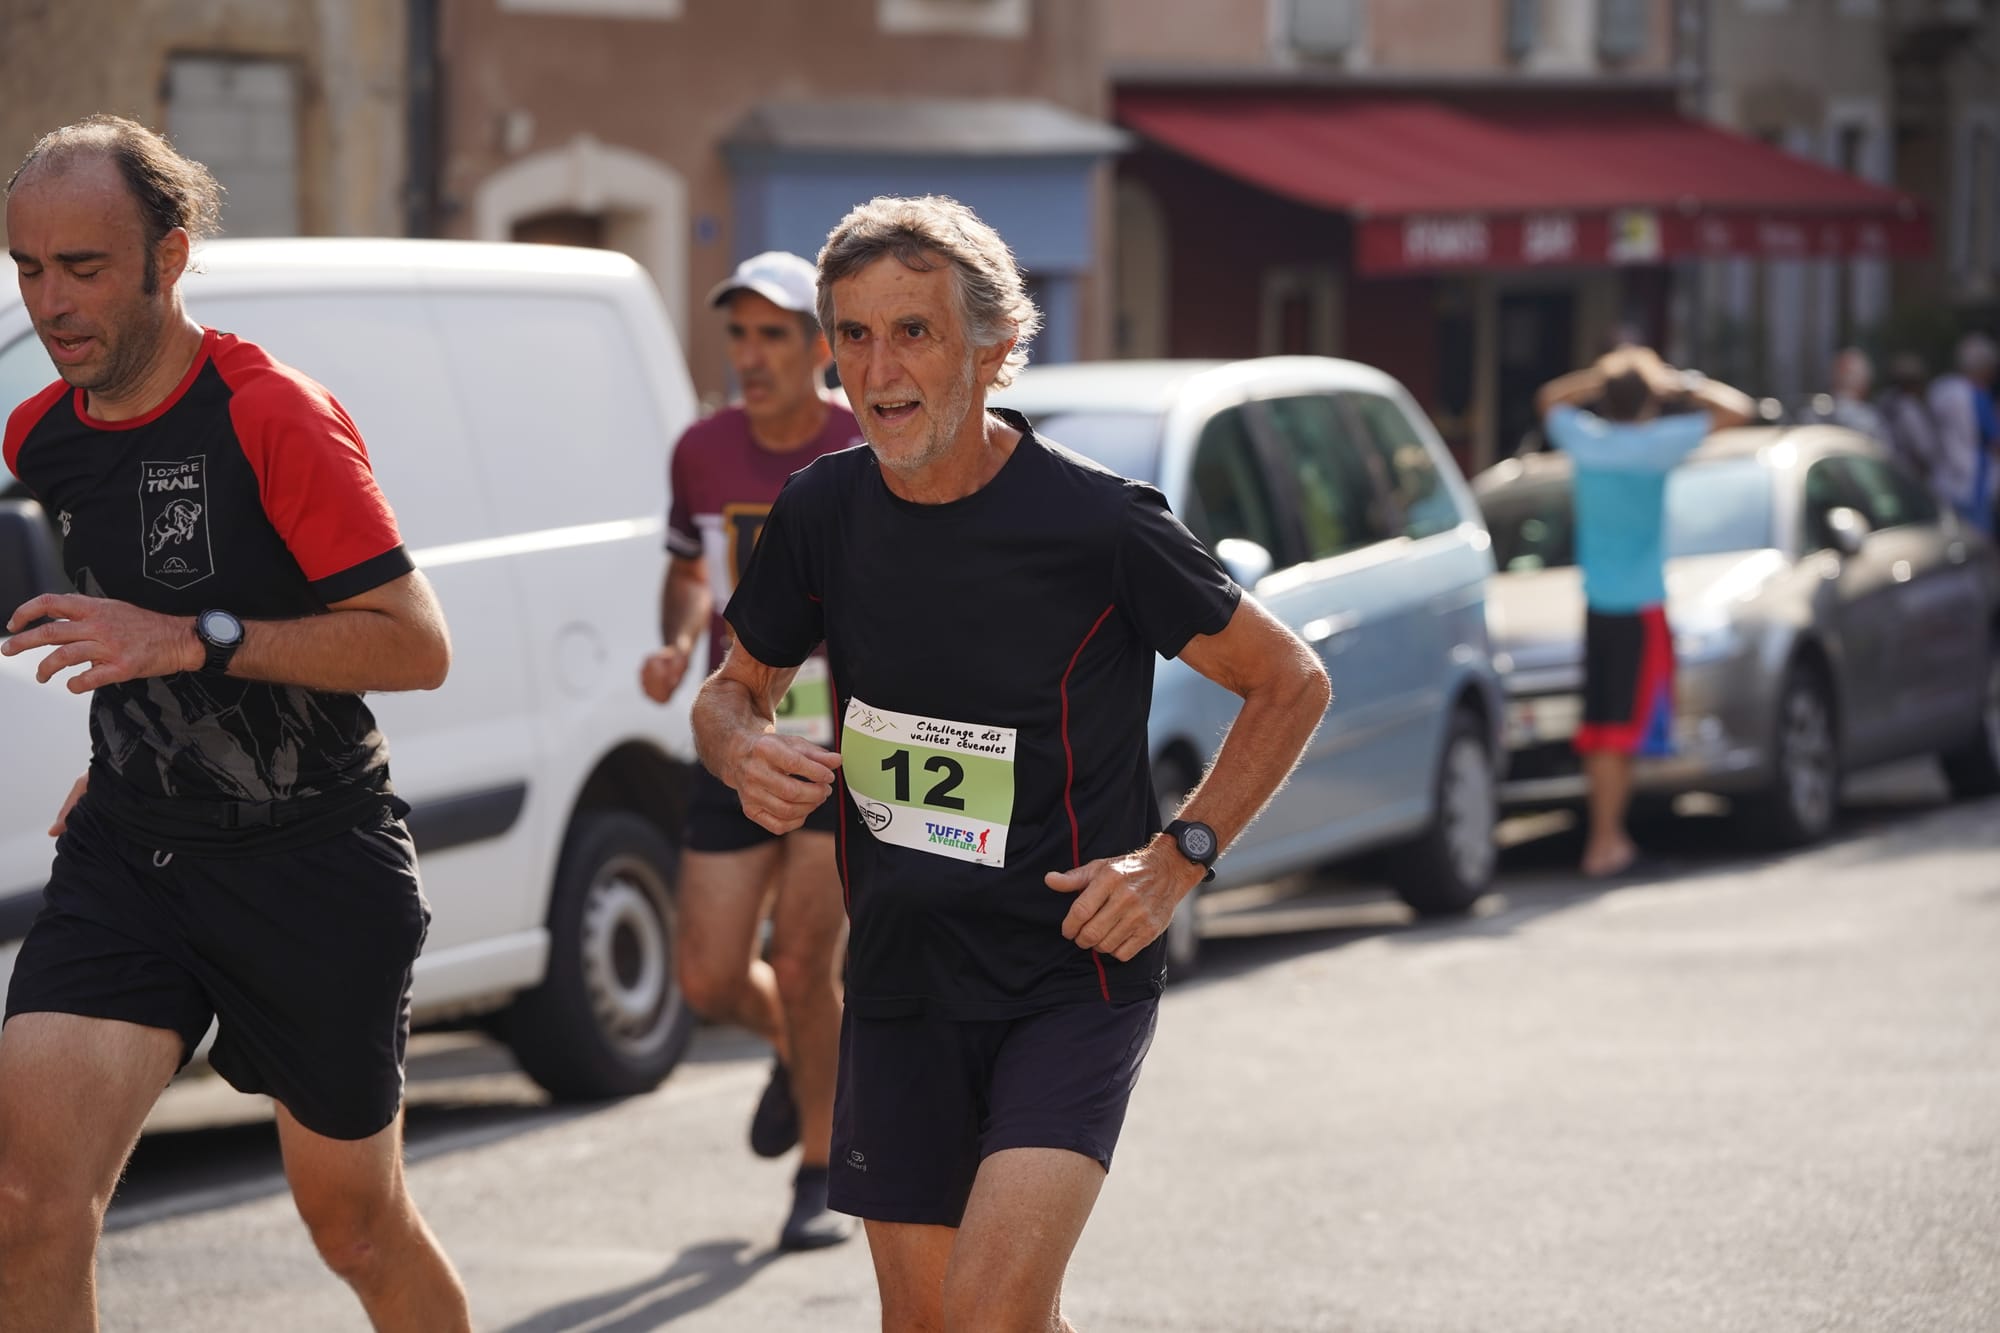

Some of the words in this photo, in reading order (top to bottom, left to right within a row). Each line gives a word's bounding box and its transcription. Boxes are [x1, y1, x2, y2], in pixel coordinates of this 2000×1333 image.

[147, 475, 200, 492] TRAIL
[910, 733, 950, 745] vallées
[917, 721, 974, 740] Challenge
[981, 731, 1001, 741] des
[881, 749, 965, 811] 12
[925, 822, 975, 843] TUFF'S
[928, 832, 977, 852] Aventure
